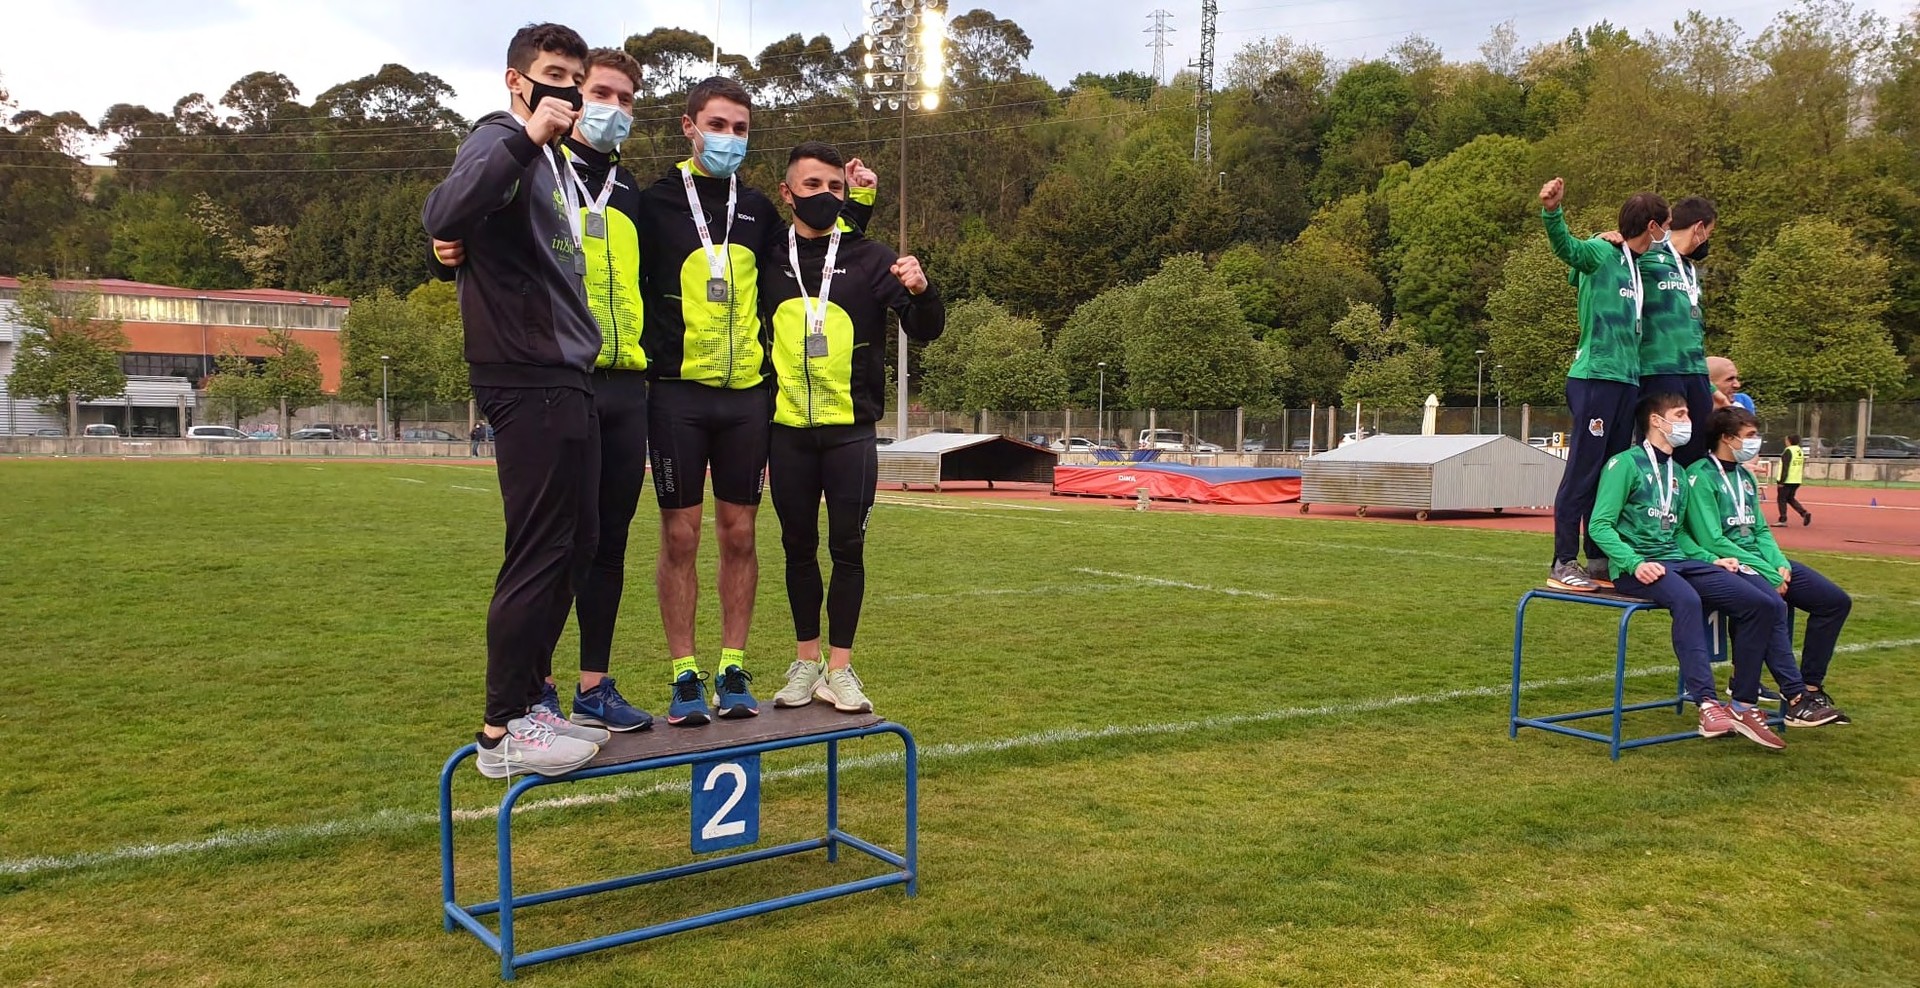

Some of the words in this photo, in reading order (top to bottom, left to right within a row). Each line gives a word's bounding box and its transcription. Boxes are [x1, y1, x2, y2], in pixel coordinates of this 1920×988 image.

[1554, 433, 1561, 444] 3
[1708, 610, 1720, 655] 1
[702, 763, 747, 840] 2
